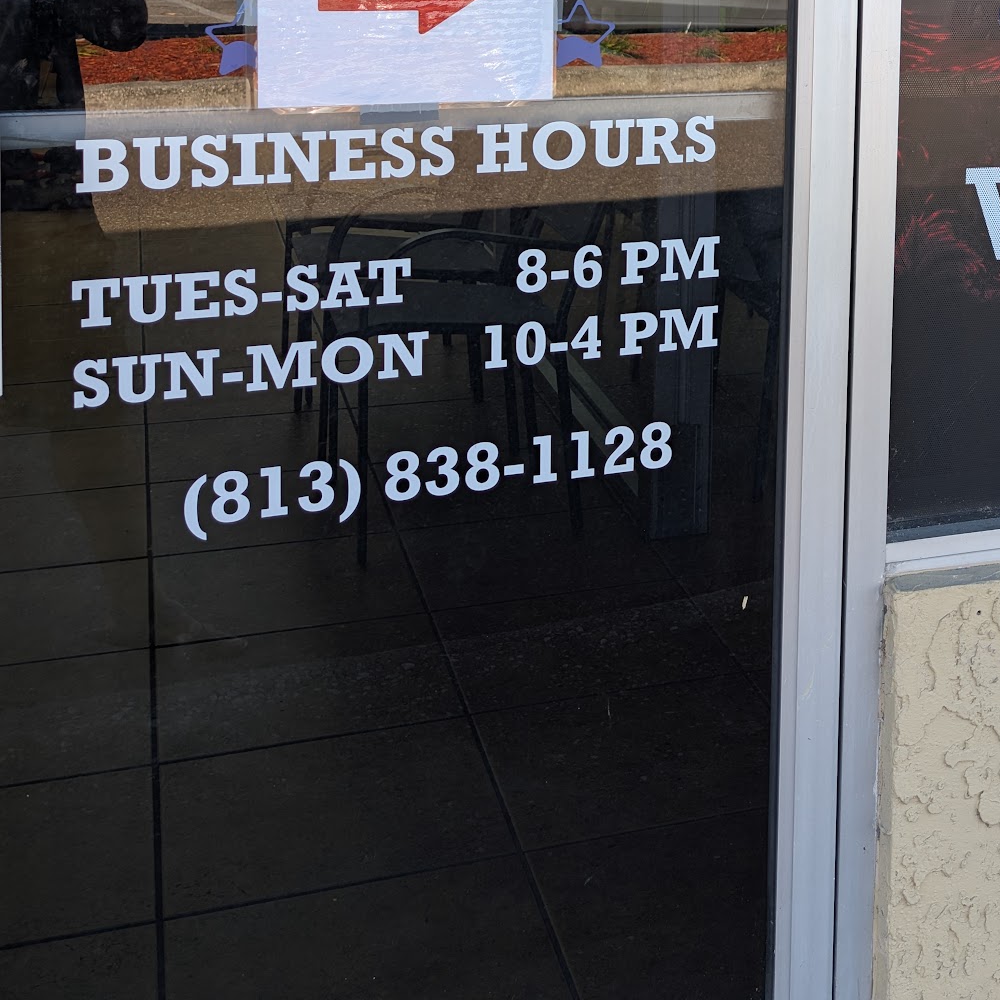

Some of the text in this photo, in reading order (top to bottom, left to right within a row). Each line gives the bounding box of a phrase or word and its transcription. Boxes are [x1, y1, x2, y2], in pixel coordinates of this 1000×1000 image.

[75, 116, 716, 193] BUSINESS HOURS
[71, 236, 721, 328] TUES-SAT 8-6 PM
[73, 305, 718, 409] SUN-MON 10-4 PM
[184, 421, 673, 541] (813) 838-1128
